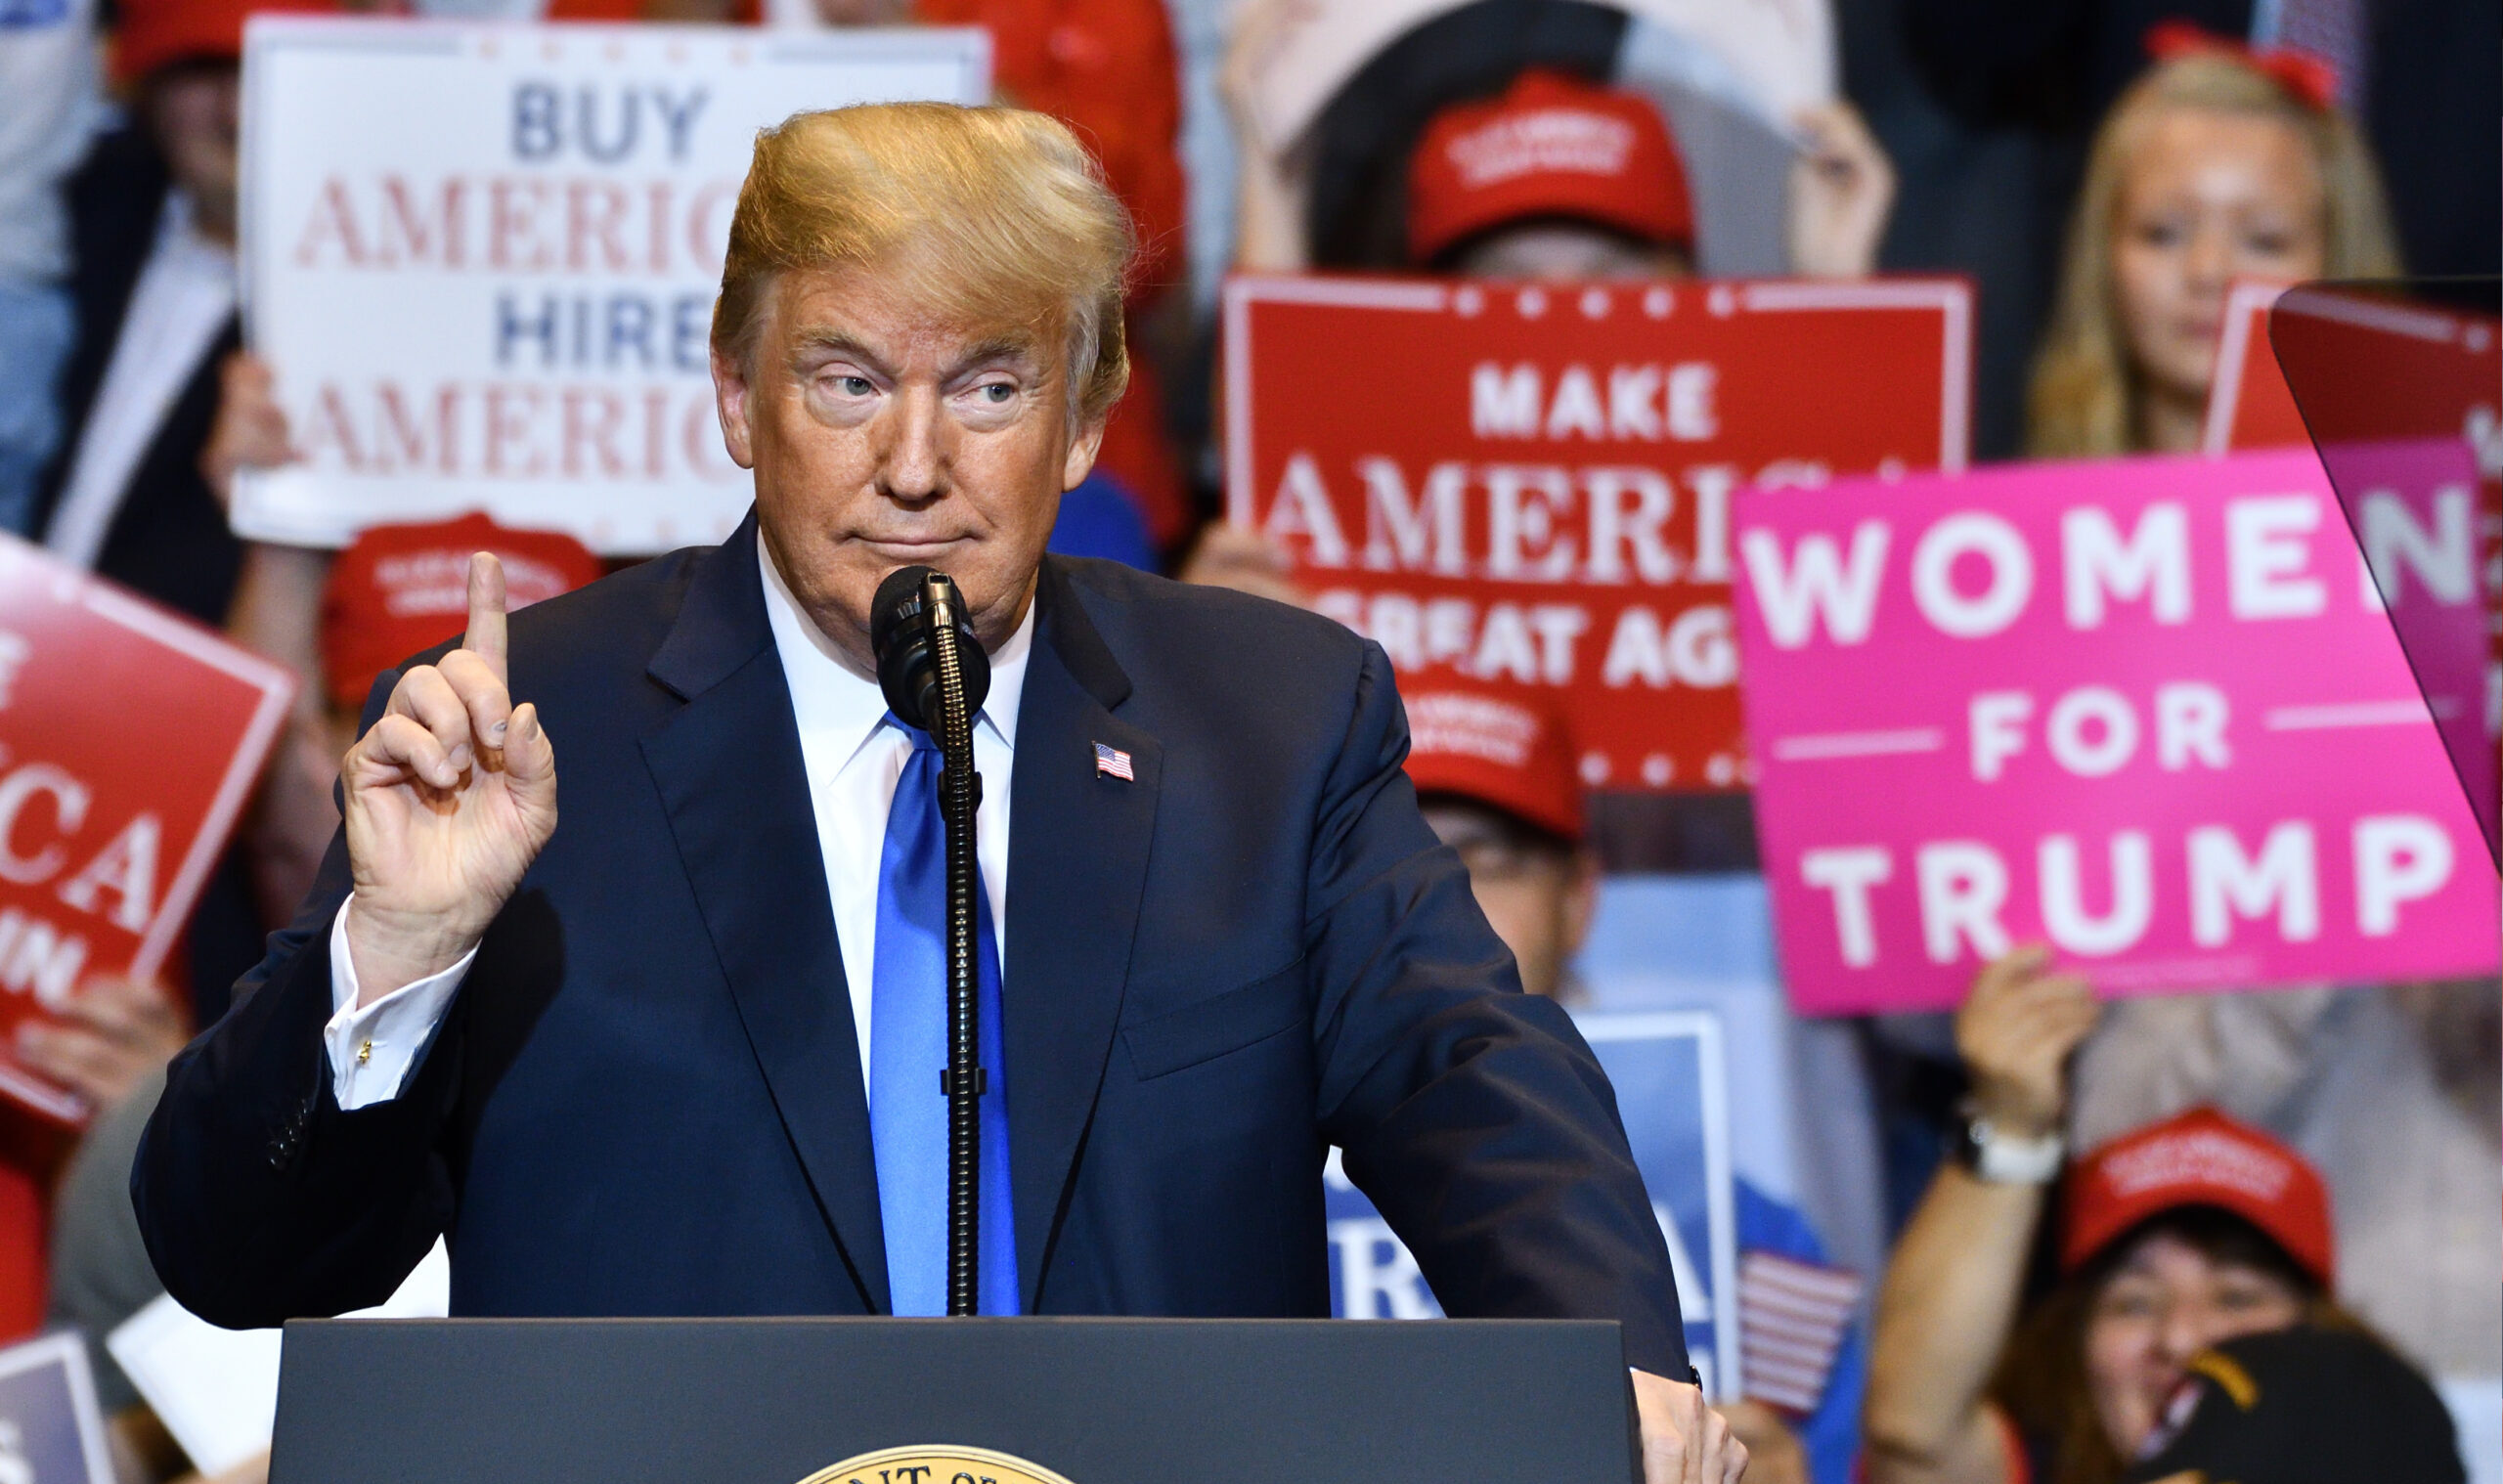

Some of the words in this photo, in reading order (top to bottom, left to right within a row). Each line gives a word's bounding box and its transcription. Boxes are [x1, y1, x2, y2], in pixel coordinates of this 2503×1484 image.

[508, 82, 711, 162] BUY
[291, 172, 739, 274] AMERIC
[495, 294, 713, 372] HIRE
[298, 383, 753, 484] AMERIC
[1472, 363, 1717, 441] MAKE
[1271, 455, 1903, 588] AMERI
[1740, 486, 2473, 647] WOMEN
[1602, 603, 1740, 688] AG
[1968, 681, 2231, 782] FOR
[1801, 813, 2455, 970] TRUMP
